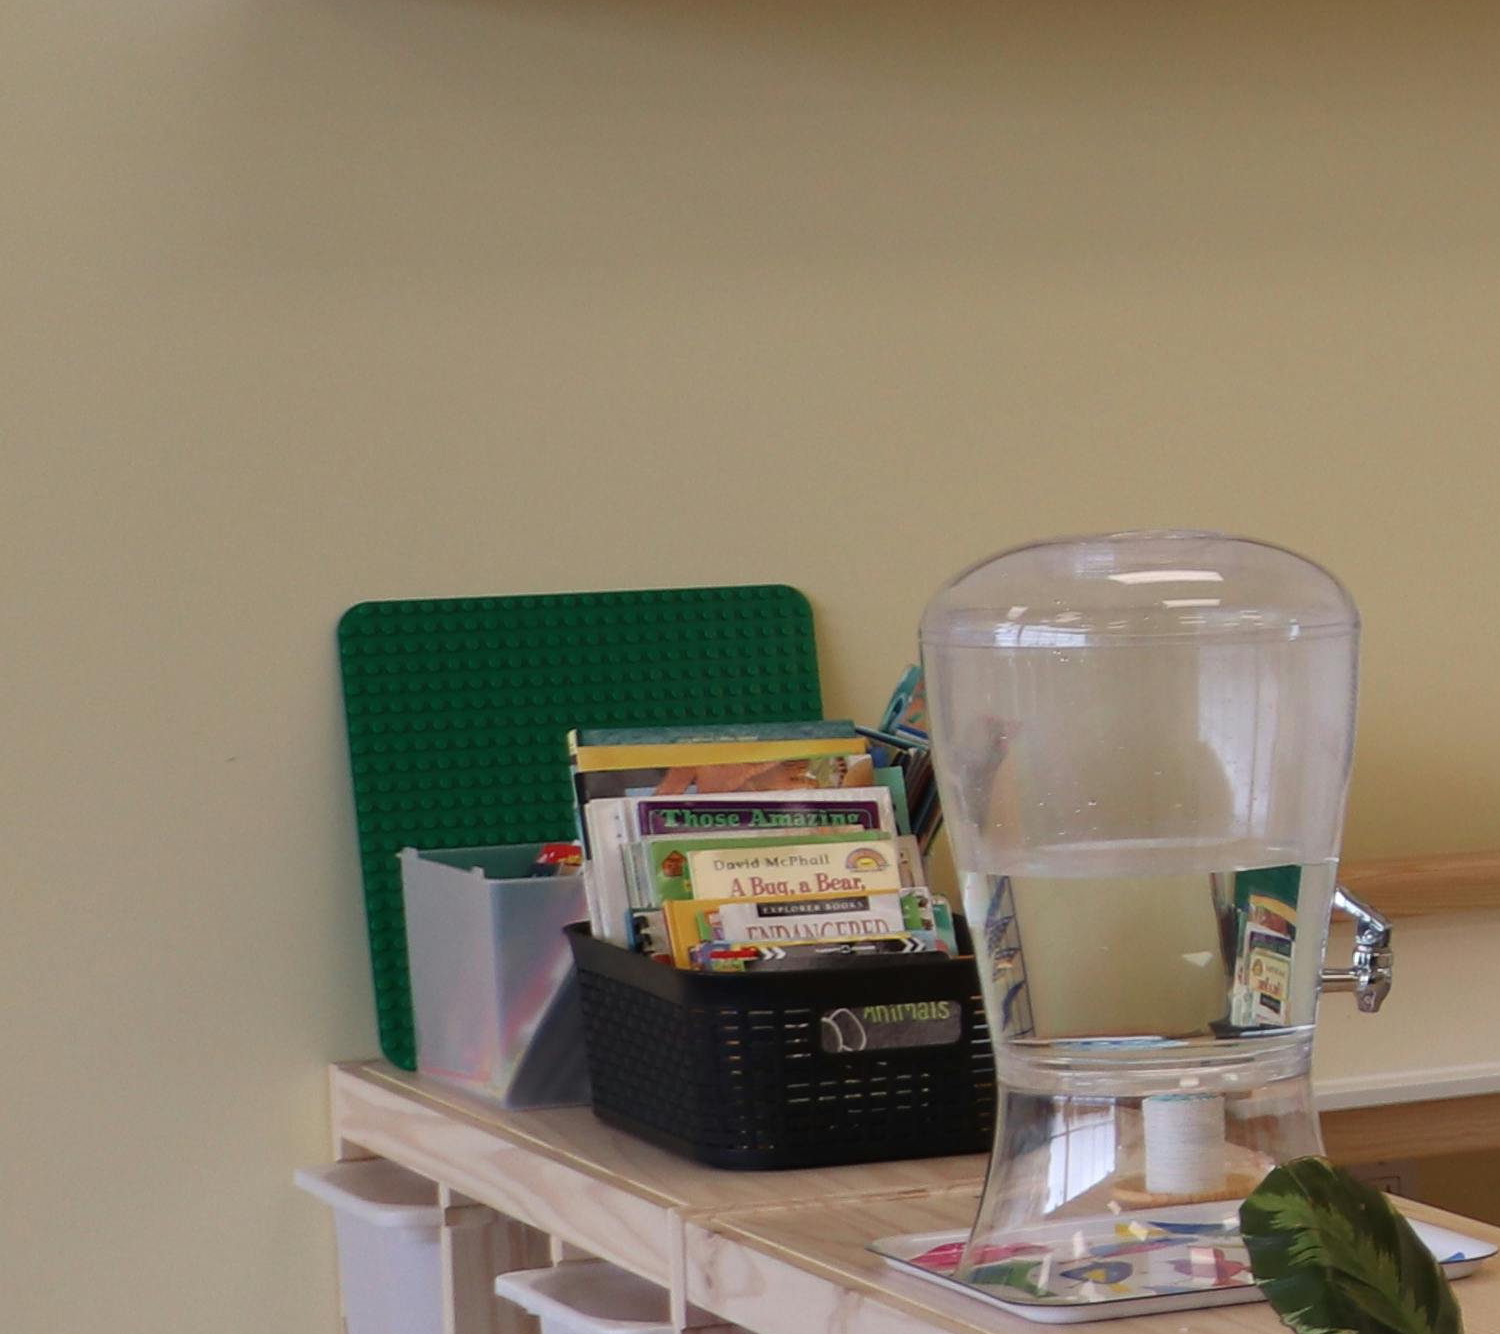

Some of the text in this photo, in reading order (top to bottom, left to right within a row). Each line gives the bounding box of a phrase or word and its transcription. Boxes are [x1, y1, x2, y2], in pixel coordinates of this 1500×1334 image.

[659, 809, 862, 829] Those Amazing
[713, 854, 830, 872] David McPhail
[731, 873, 867, 897] A Bug, a Bear,
[762, 900, 866, 915] EXPLORER BOOKS
